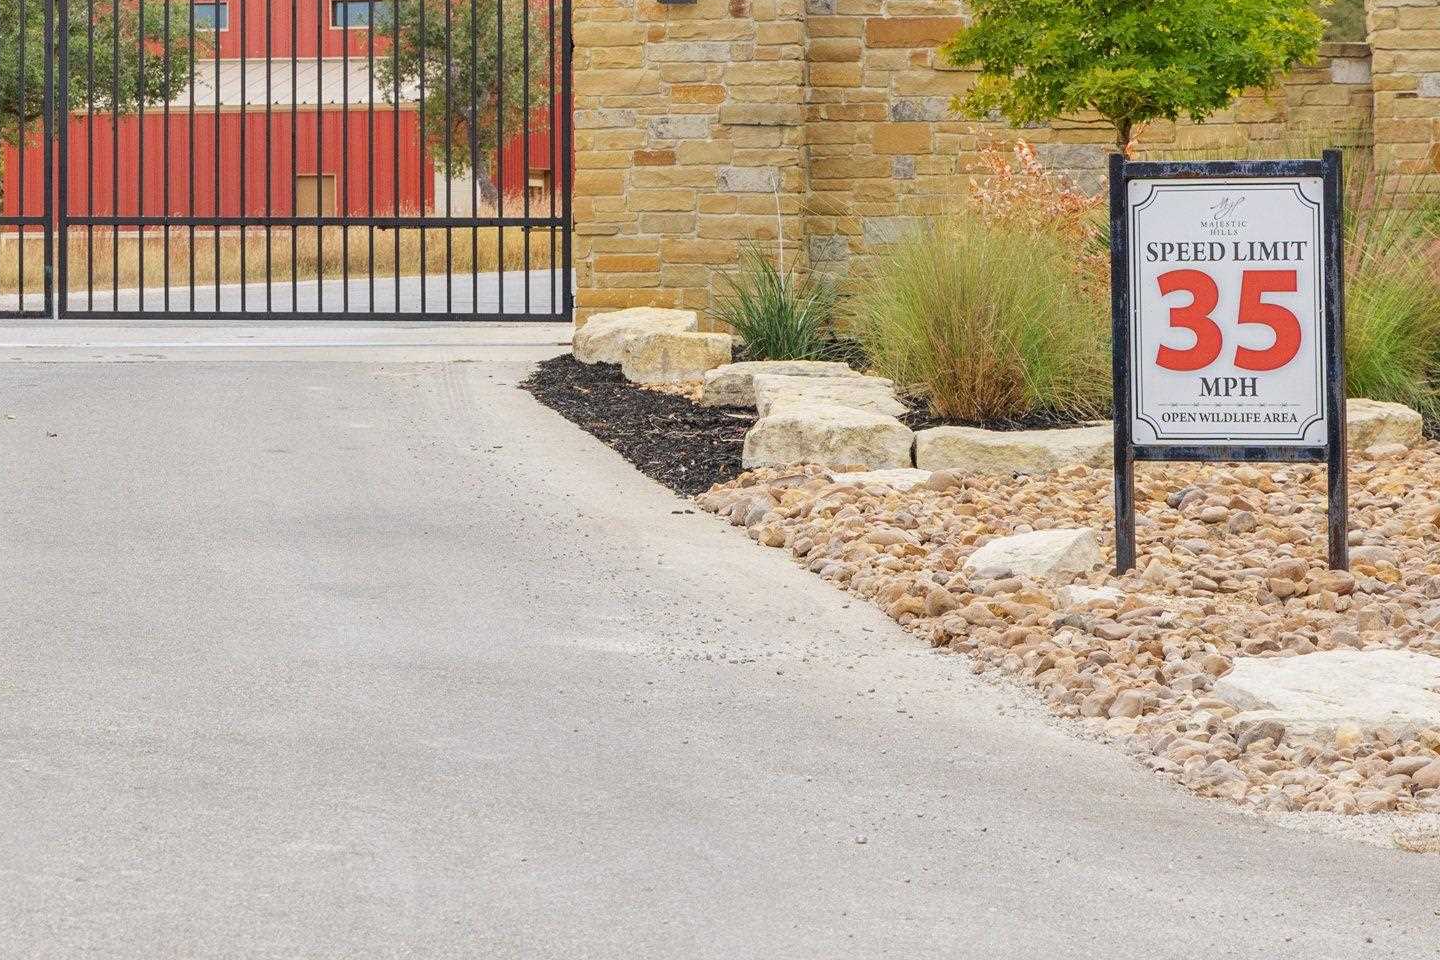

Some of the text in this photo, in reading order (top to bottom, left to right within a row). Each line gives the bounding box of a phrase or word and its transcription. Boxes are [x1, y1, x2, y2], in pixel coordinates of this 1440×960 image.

[1146, 241, 1308, 262] SPEED LIMIT
[1155, 269, 1302, 372] 35
[1198, 377, 1259, 397] MPH
[1161, 412, 1298, 423] OPEN WILDLIFE AREA
